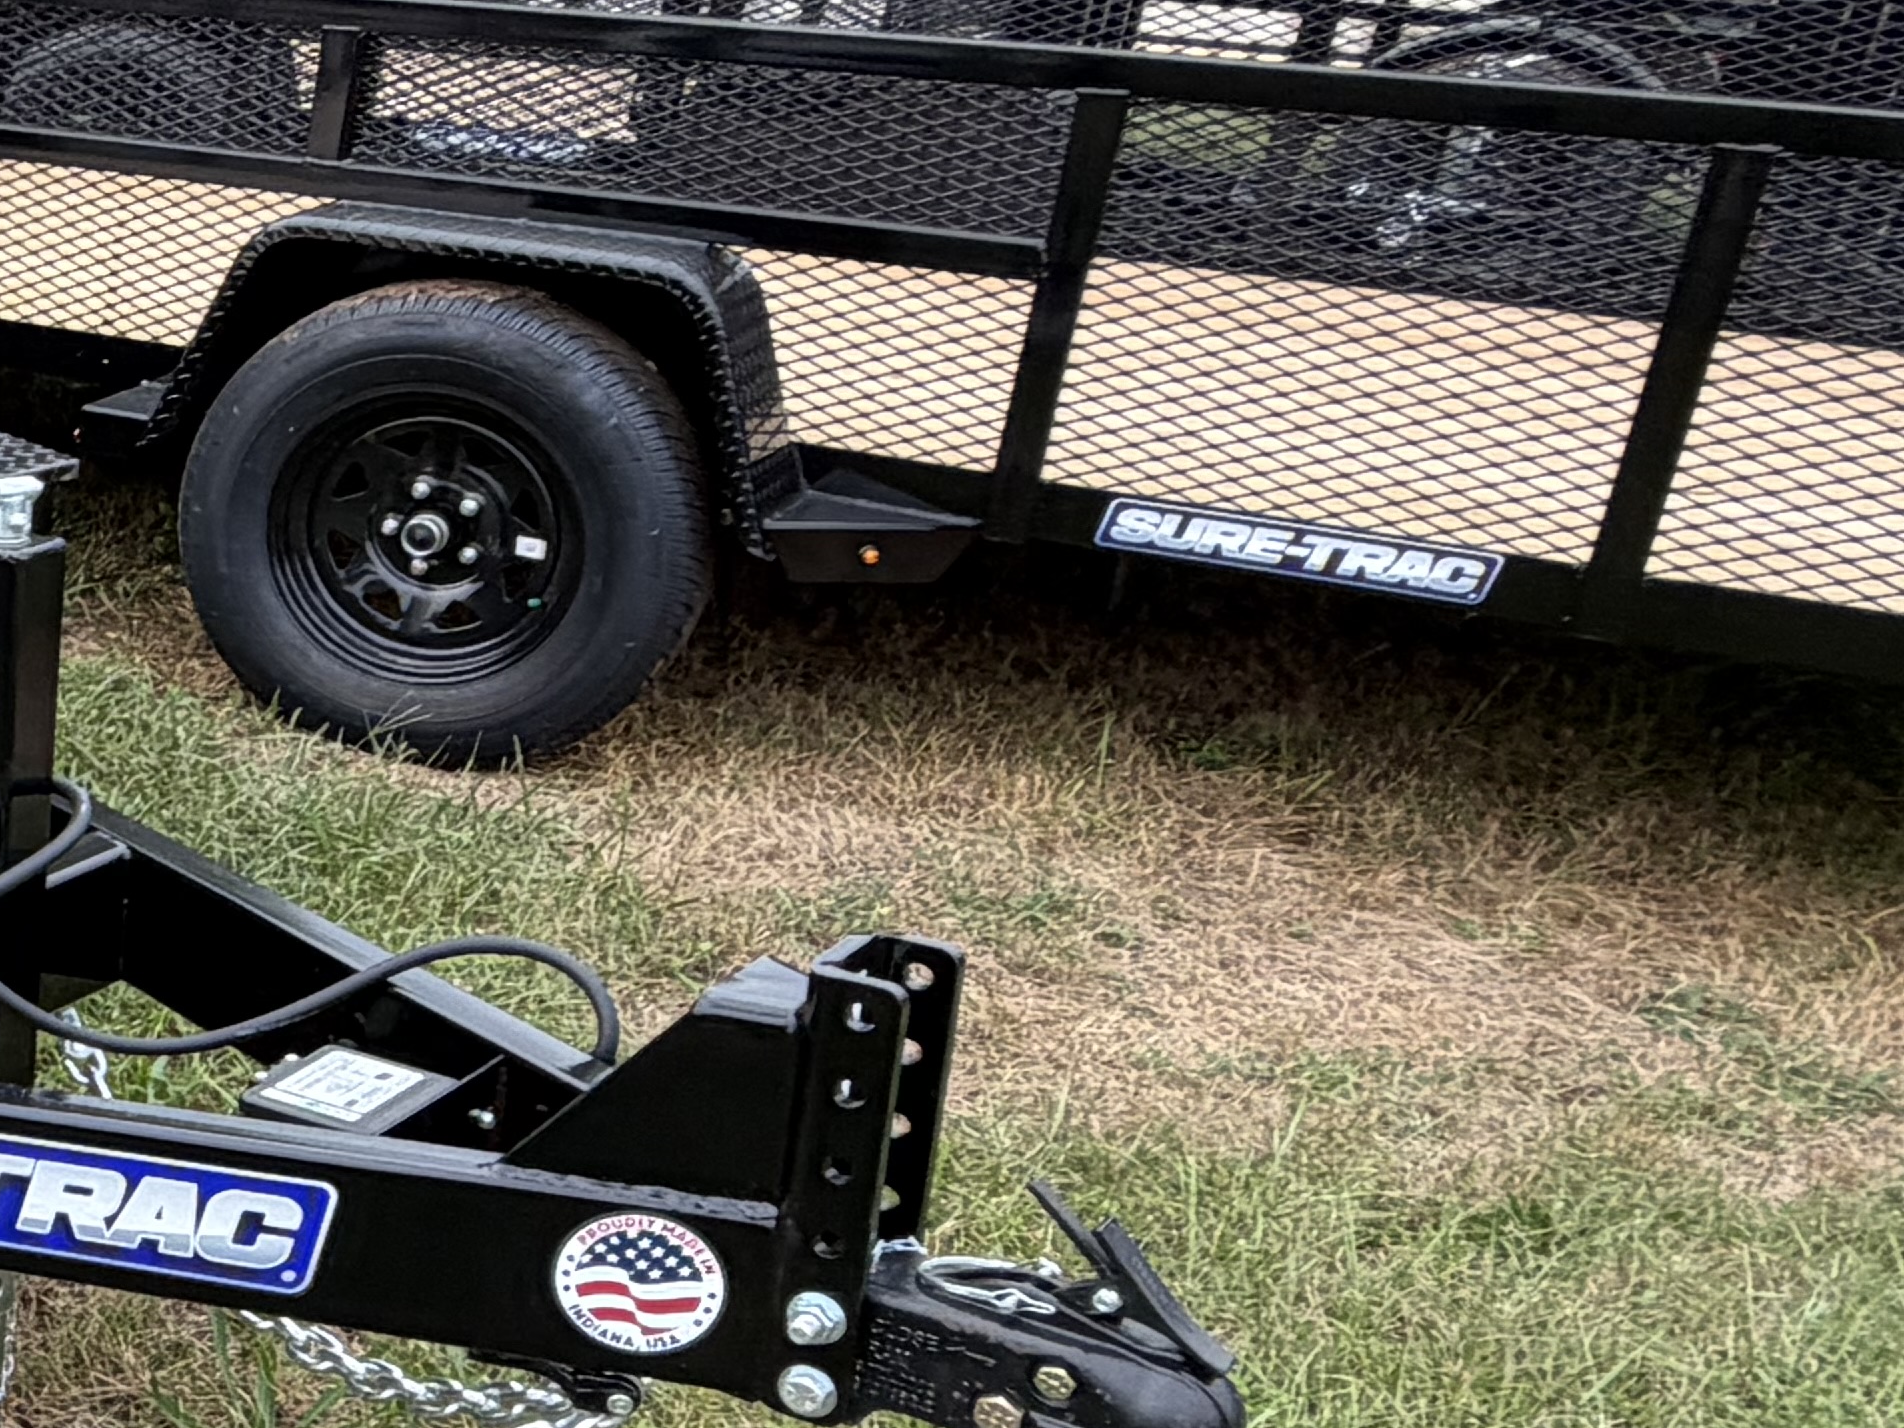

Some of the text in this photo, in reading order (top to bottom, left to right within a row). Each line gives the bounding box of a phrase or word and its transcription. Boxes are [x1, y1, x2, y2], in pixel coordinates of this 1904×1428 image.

[1109, 508, 1486, 595] SURE-TRAC
[661, 1223, 705, 1257] MADE
[646, 1334, 682, 1349] USA
